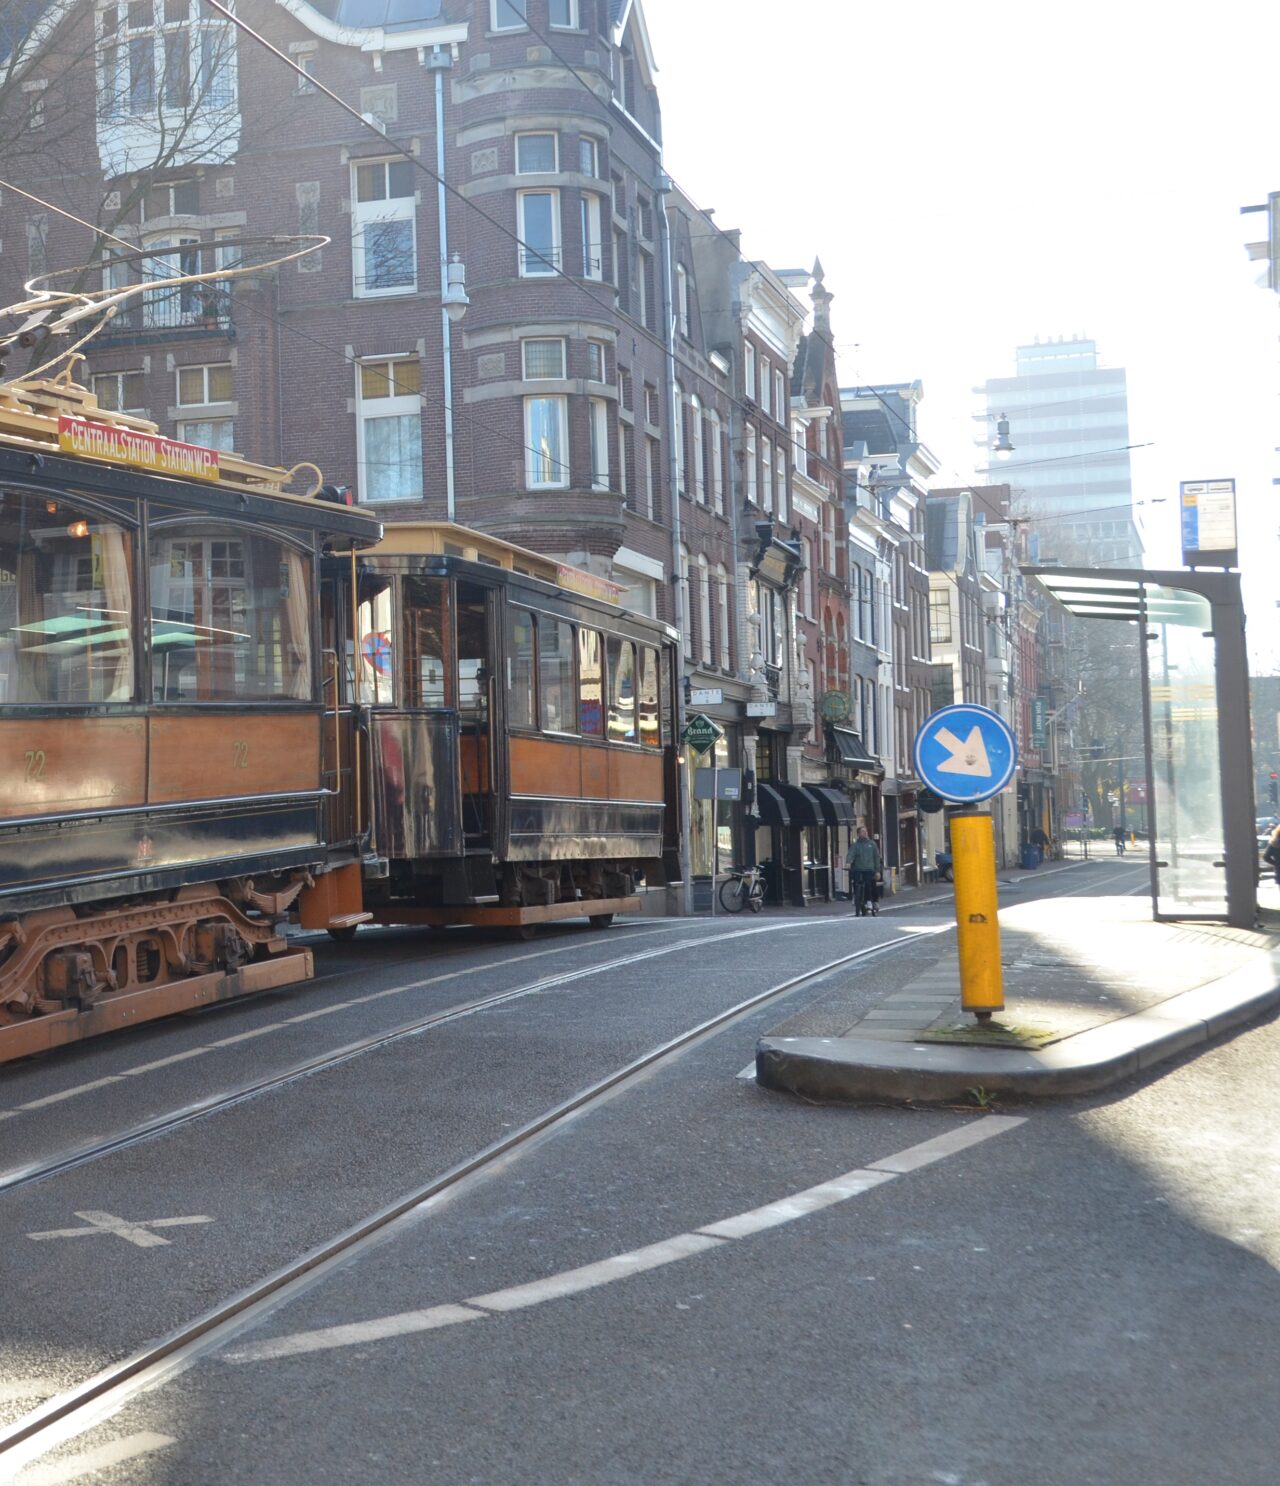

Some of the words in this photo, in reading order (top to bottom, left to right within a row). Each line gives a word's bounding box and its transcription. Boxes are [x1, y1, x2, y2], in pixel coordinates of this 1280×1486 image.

[692, 689, 720, 697] DANTE
[687, 726, 713, 736] Brand
[232, 741, 249, 769] 72
[23, 750, 46, 784] 72
